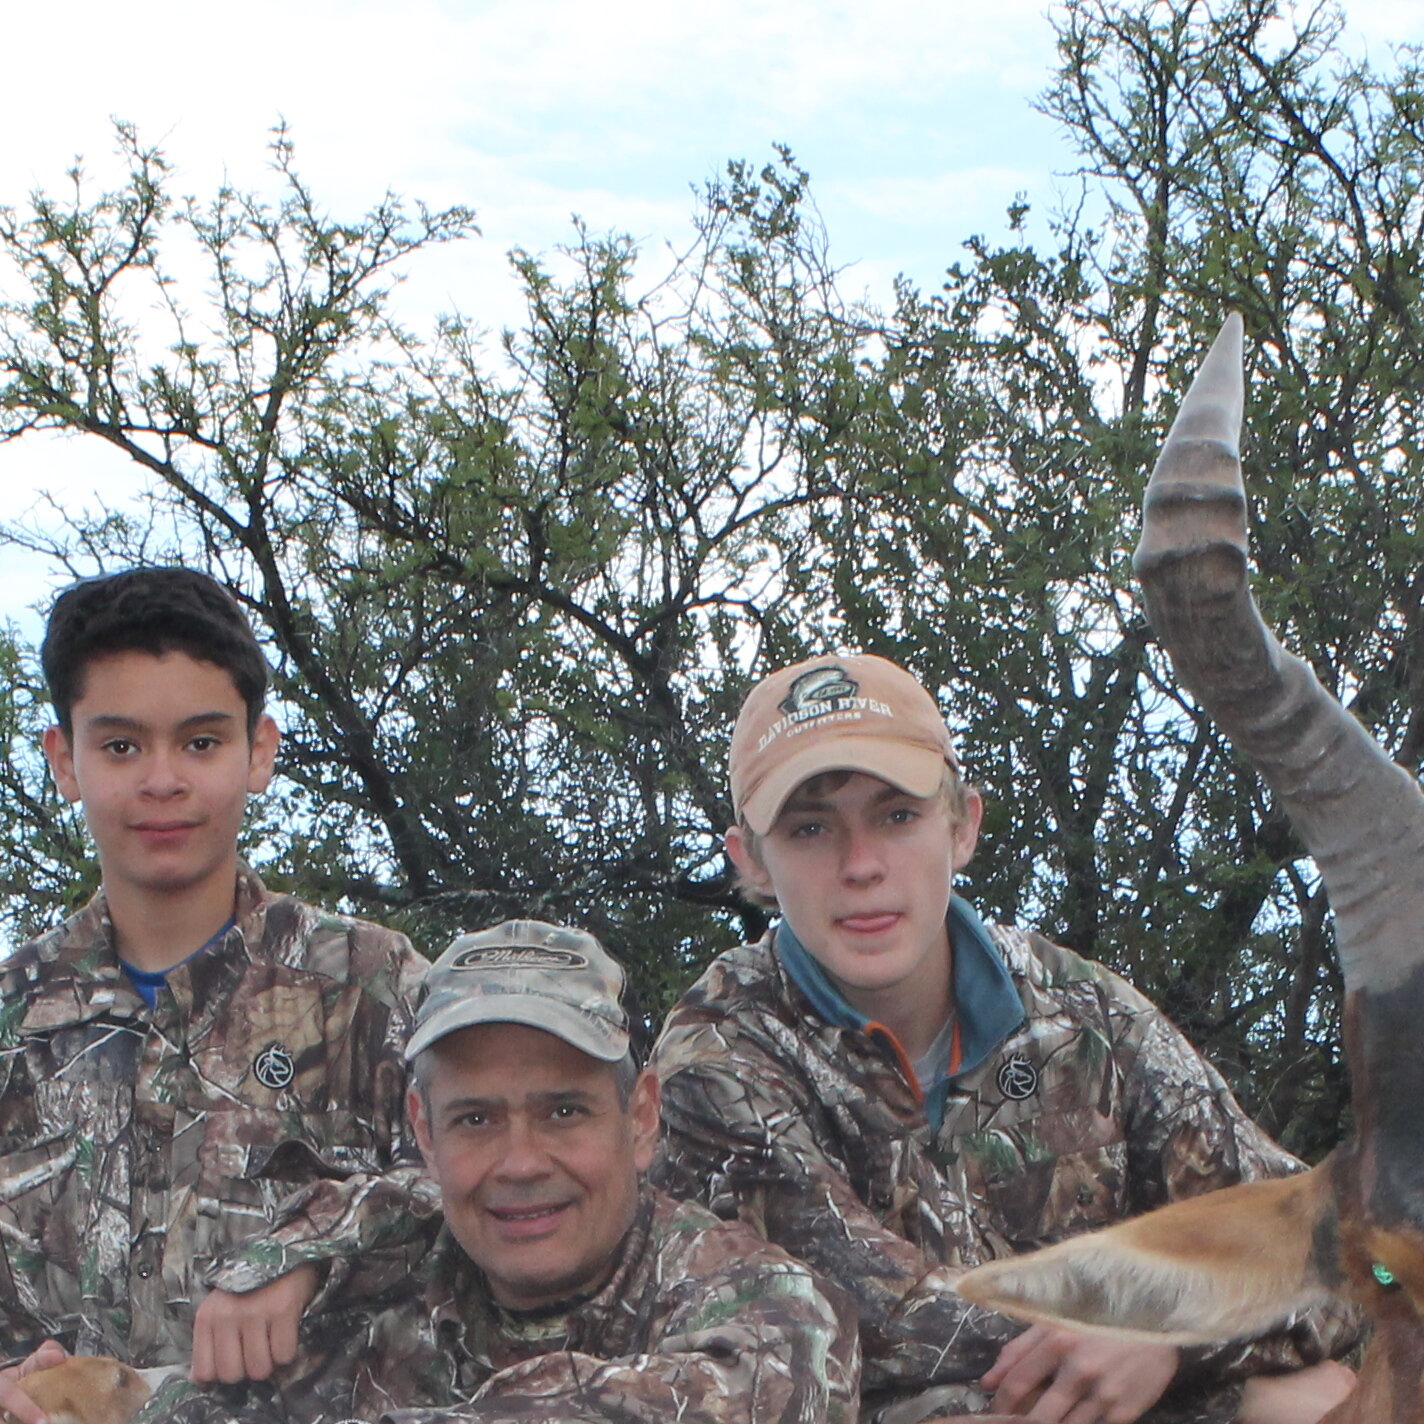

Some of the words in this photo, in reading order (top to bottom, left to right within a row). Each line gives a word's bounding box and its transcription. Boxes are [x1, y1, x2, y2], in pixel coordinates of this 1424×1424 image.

[758, 700, 833, 752] DAVIDSON
[837, 697, 893, 717] RIVER
[787, 712, 862, 737] OUTFITTERS
